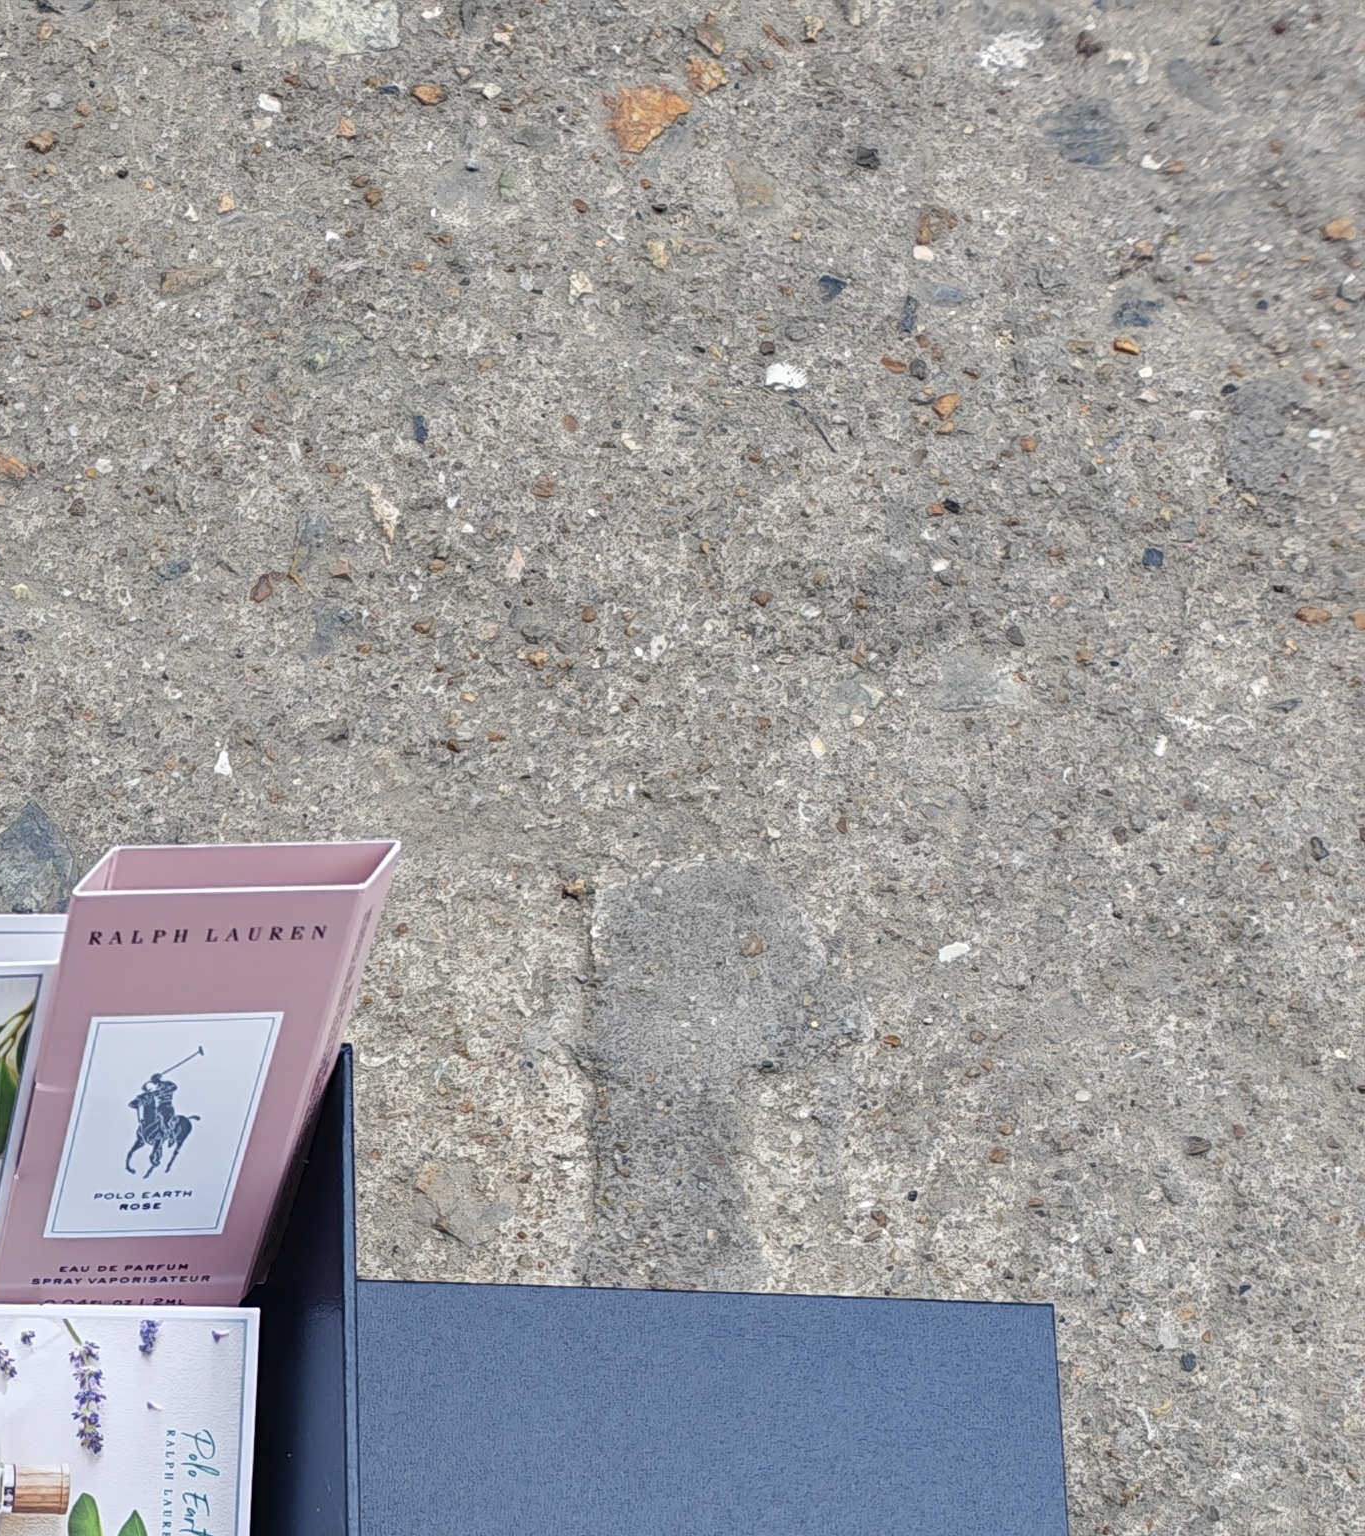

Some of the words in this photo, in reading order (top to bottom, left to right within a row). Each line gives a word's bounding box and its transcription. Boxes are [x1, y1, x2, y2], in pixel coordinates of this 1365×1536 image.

[87, 928, 190, 945] RALPH
[205, 925, 328, 943] LAUREN
[94, 1192, 136, 1200] POLO
[141, 1190, 193, 1199] EARTH
[119, 1202, 162, 1211] ROSE
[59, 1265, 91, 1274] EAU
[124, 1263, 190, 1272] PARFUM
[31, 1277, 83, 1286] SPRAY
[88, 1275, 211, 1285] VAPORISATEUR
[164, 1429, 176, 1480] RALPH
[180, 1429, 220, 1477] Polo
